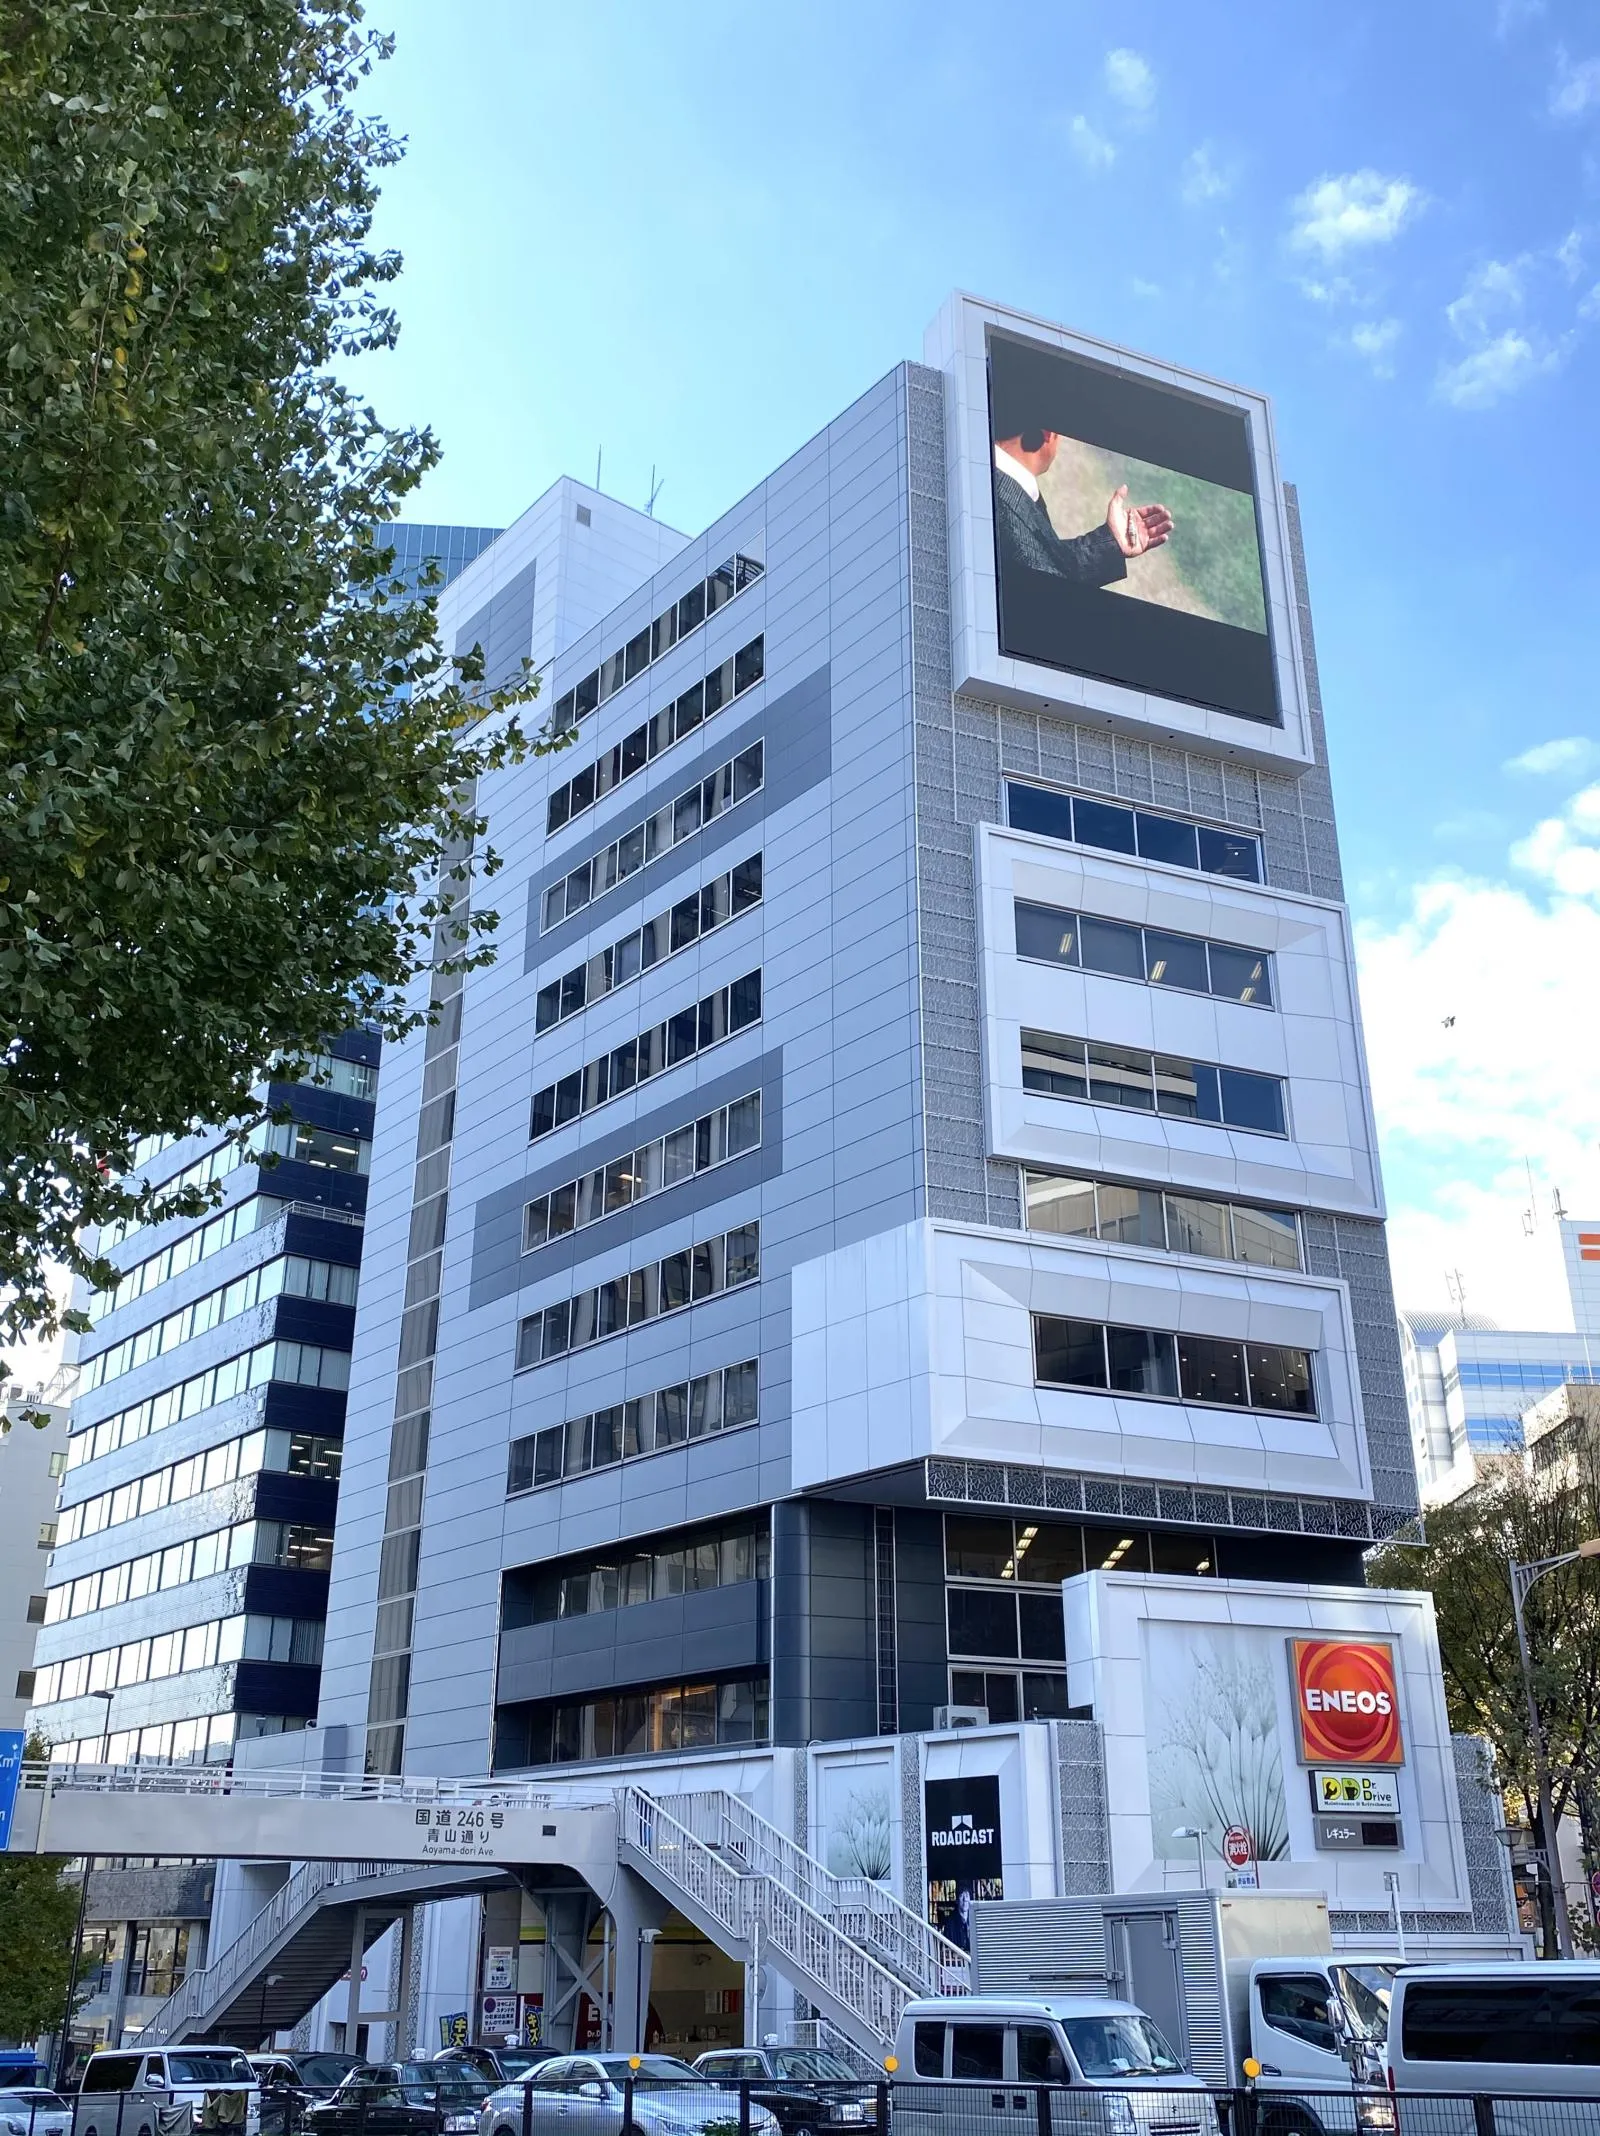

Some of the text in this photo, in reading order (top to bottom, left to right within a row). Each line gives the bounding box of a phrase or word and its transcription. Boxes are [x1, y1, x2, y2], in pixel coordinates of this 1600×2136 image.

[1305, 1688, 1392, 1715] ENEOS
[1362, 1778, 1377, 1789] Dr.
[1363, 1790, 1392, 1801] Drive
[427, 1828, 490, 1844] 青山通り
[931, 1828, 994, 1847] ROADCAST
[1326, 1827, 1356, 1839] レギュラー
[422, 1844, 476, 1856] Aoyama-dori
